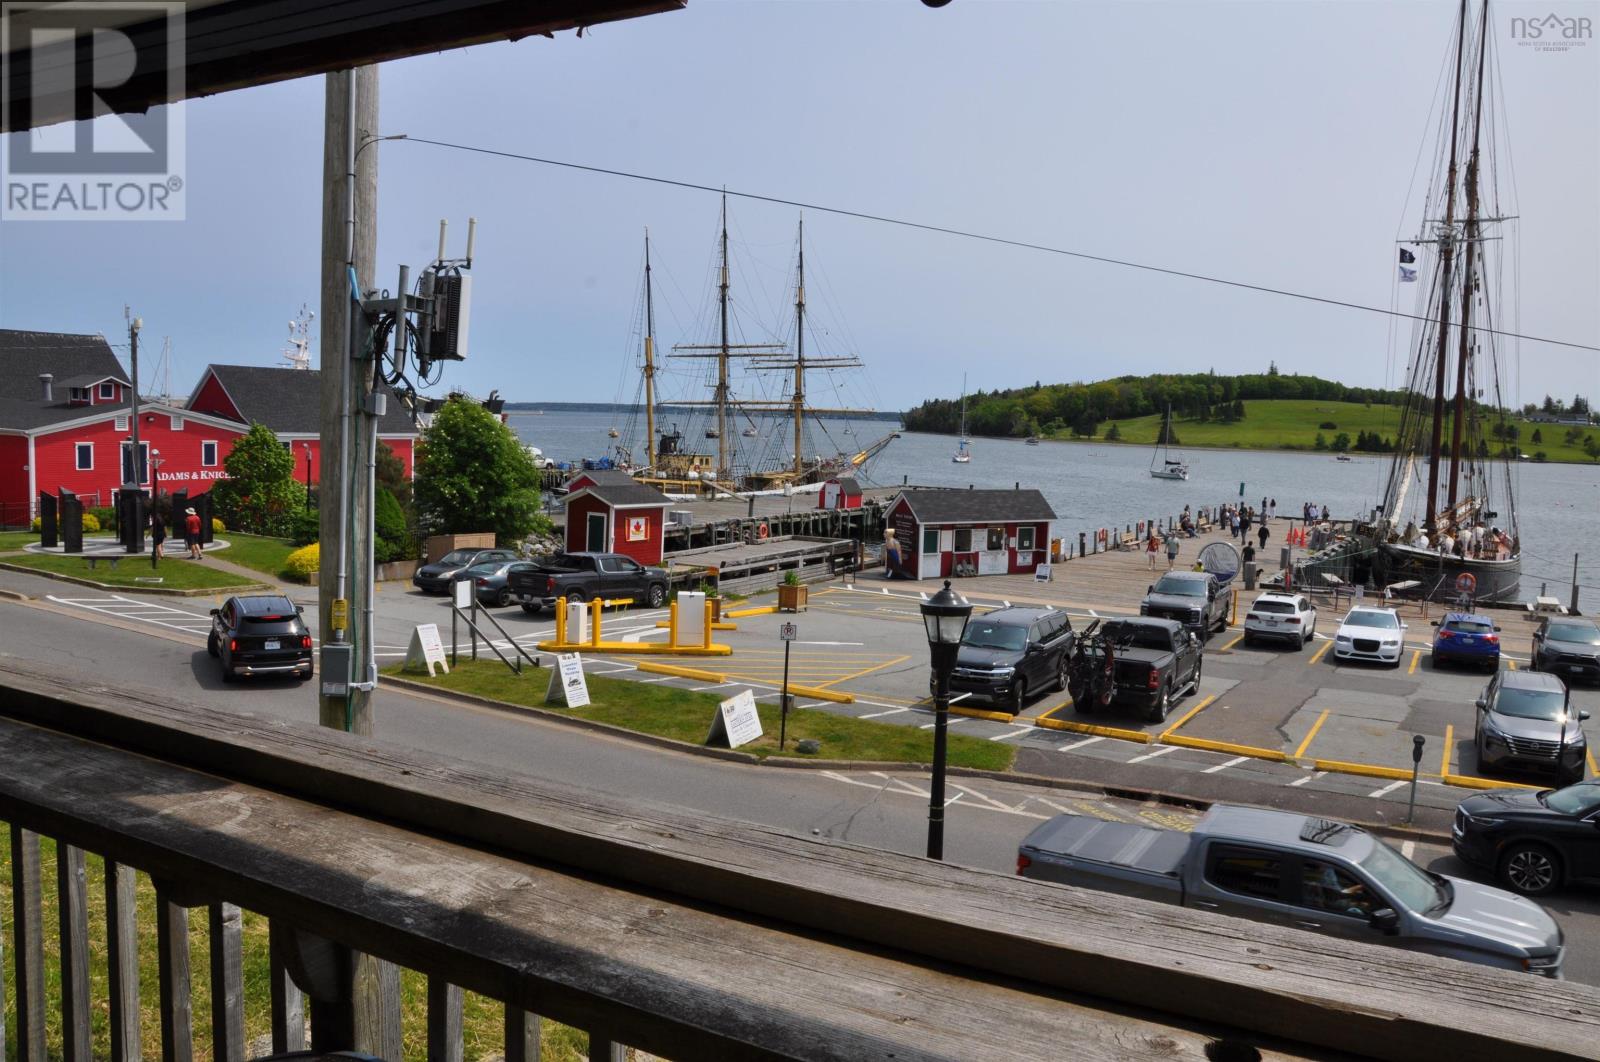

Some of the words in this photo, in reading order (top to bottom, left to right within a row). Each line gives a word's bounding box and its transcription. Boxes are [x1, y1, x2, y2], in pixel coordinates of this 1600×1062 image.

[157, 471, 190, 480] ADAMS
[191, 471, 199, 480] &
[200, 470, 241, 480] KNIC
